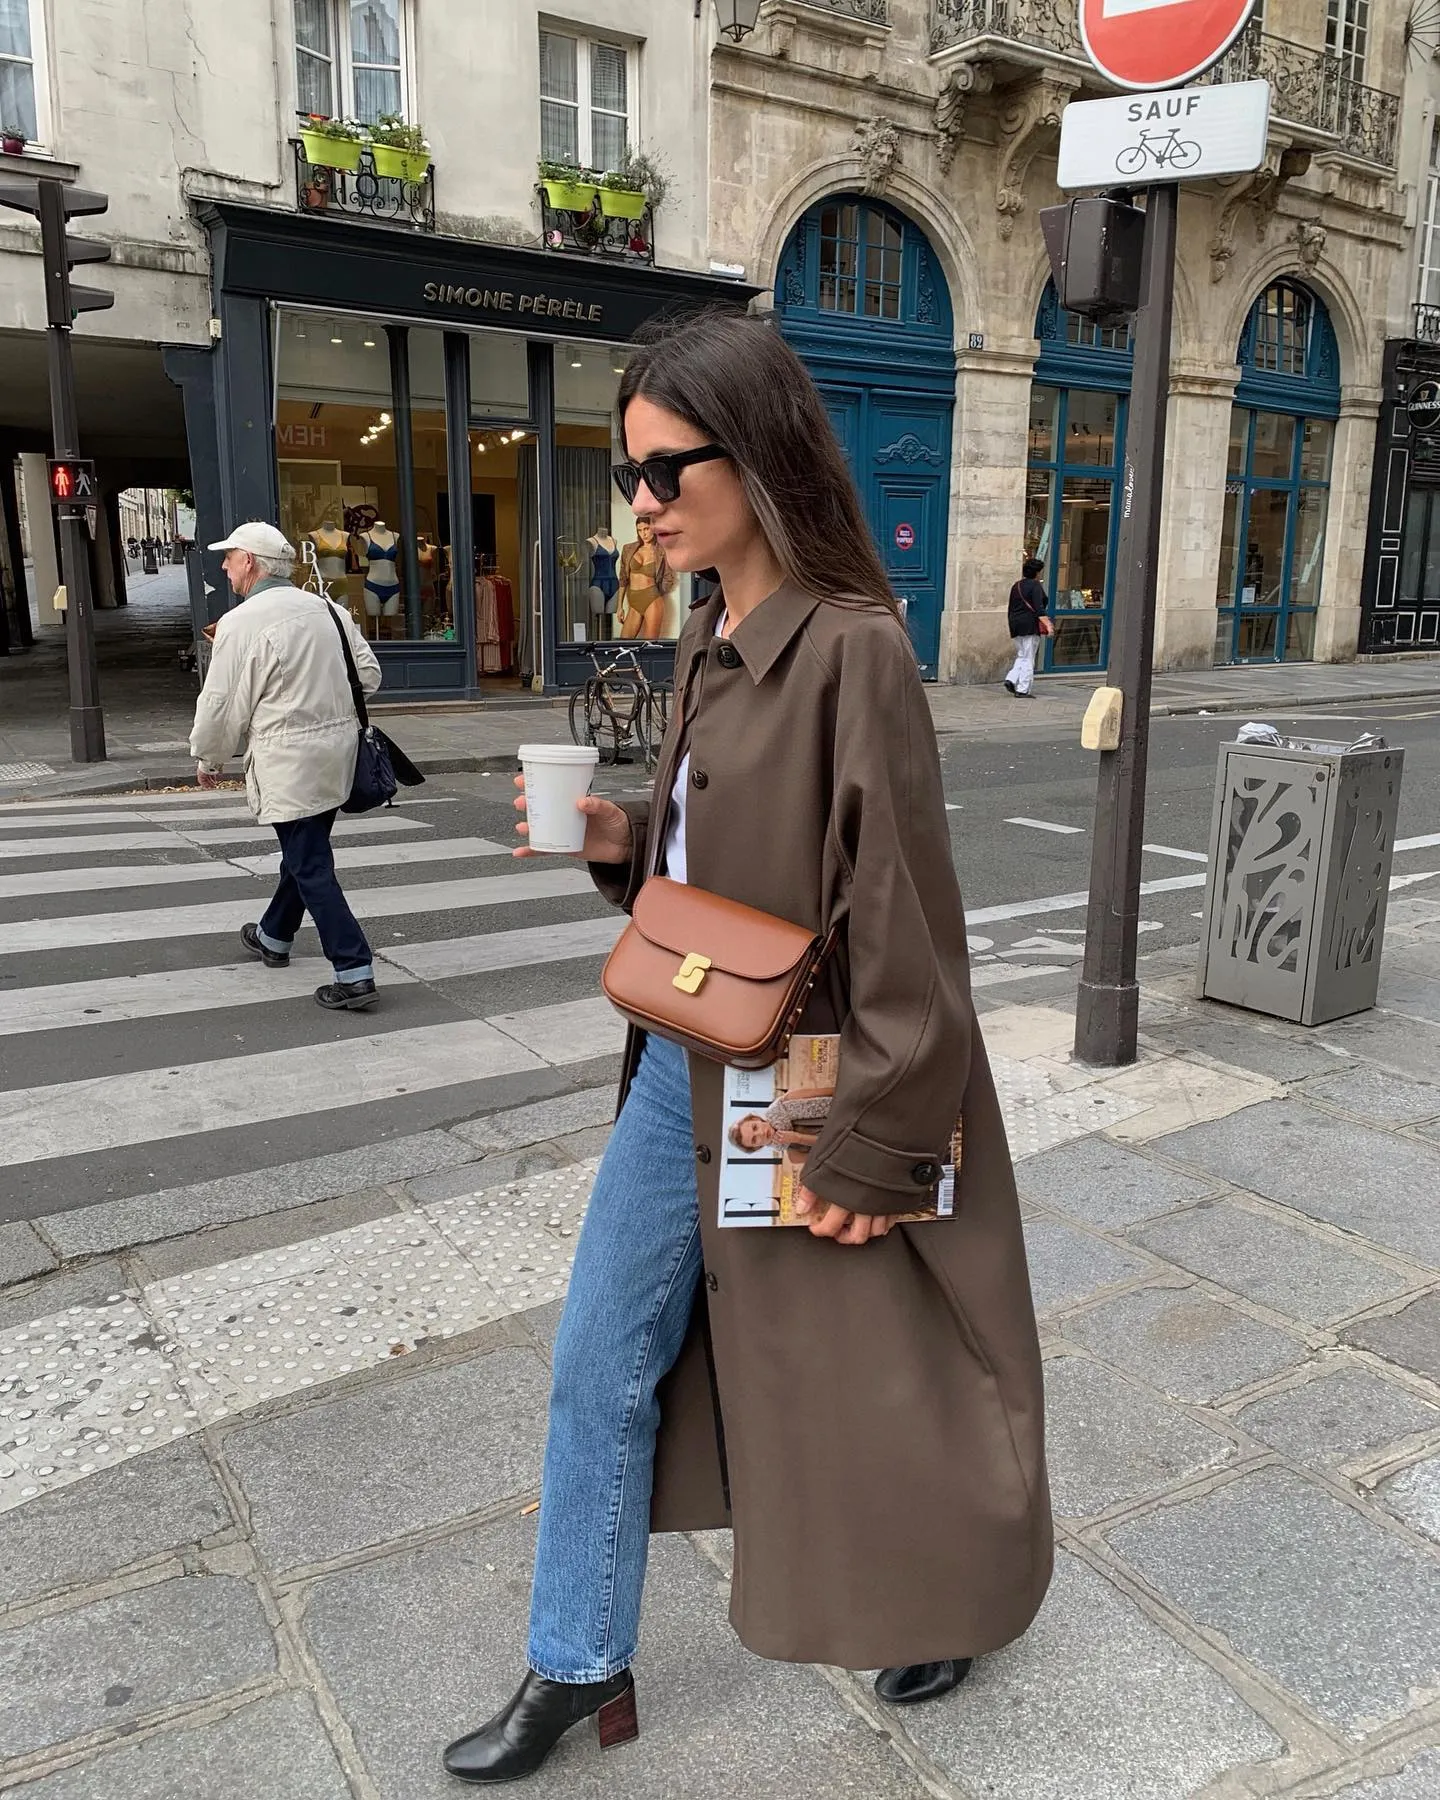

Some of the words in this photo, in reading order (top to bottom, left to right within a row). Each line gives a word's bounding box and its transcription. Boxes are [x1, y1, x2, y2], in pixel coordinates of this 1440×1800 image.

[1128, 96, 1200, 122] SAUF
[423, 282, 514, 312] SIMONE
[518, 293, 603, 322] PÉRÈLE
